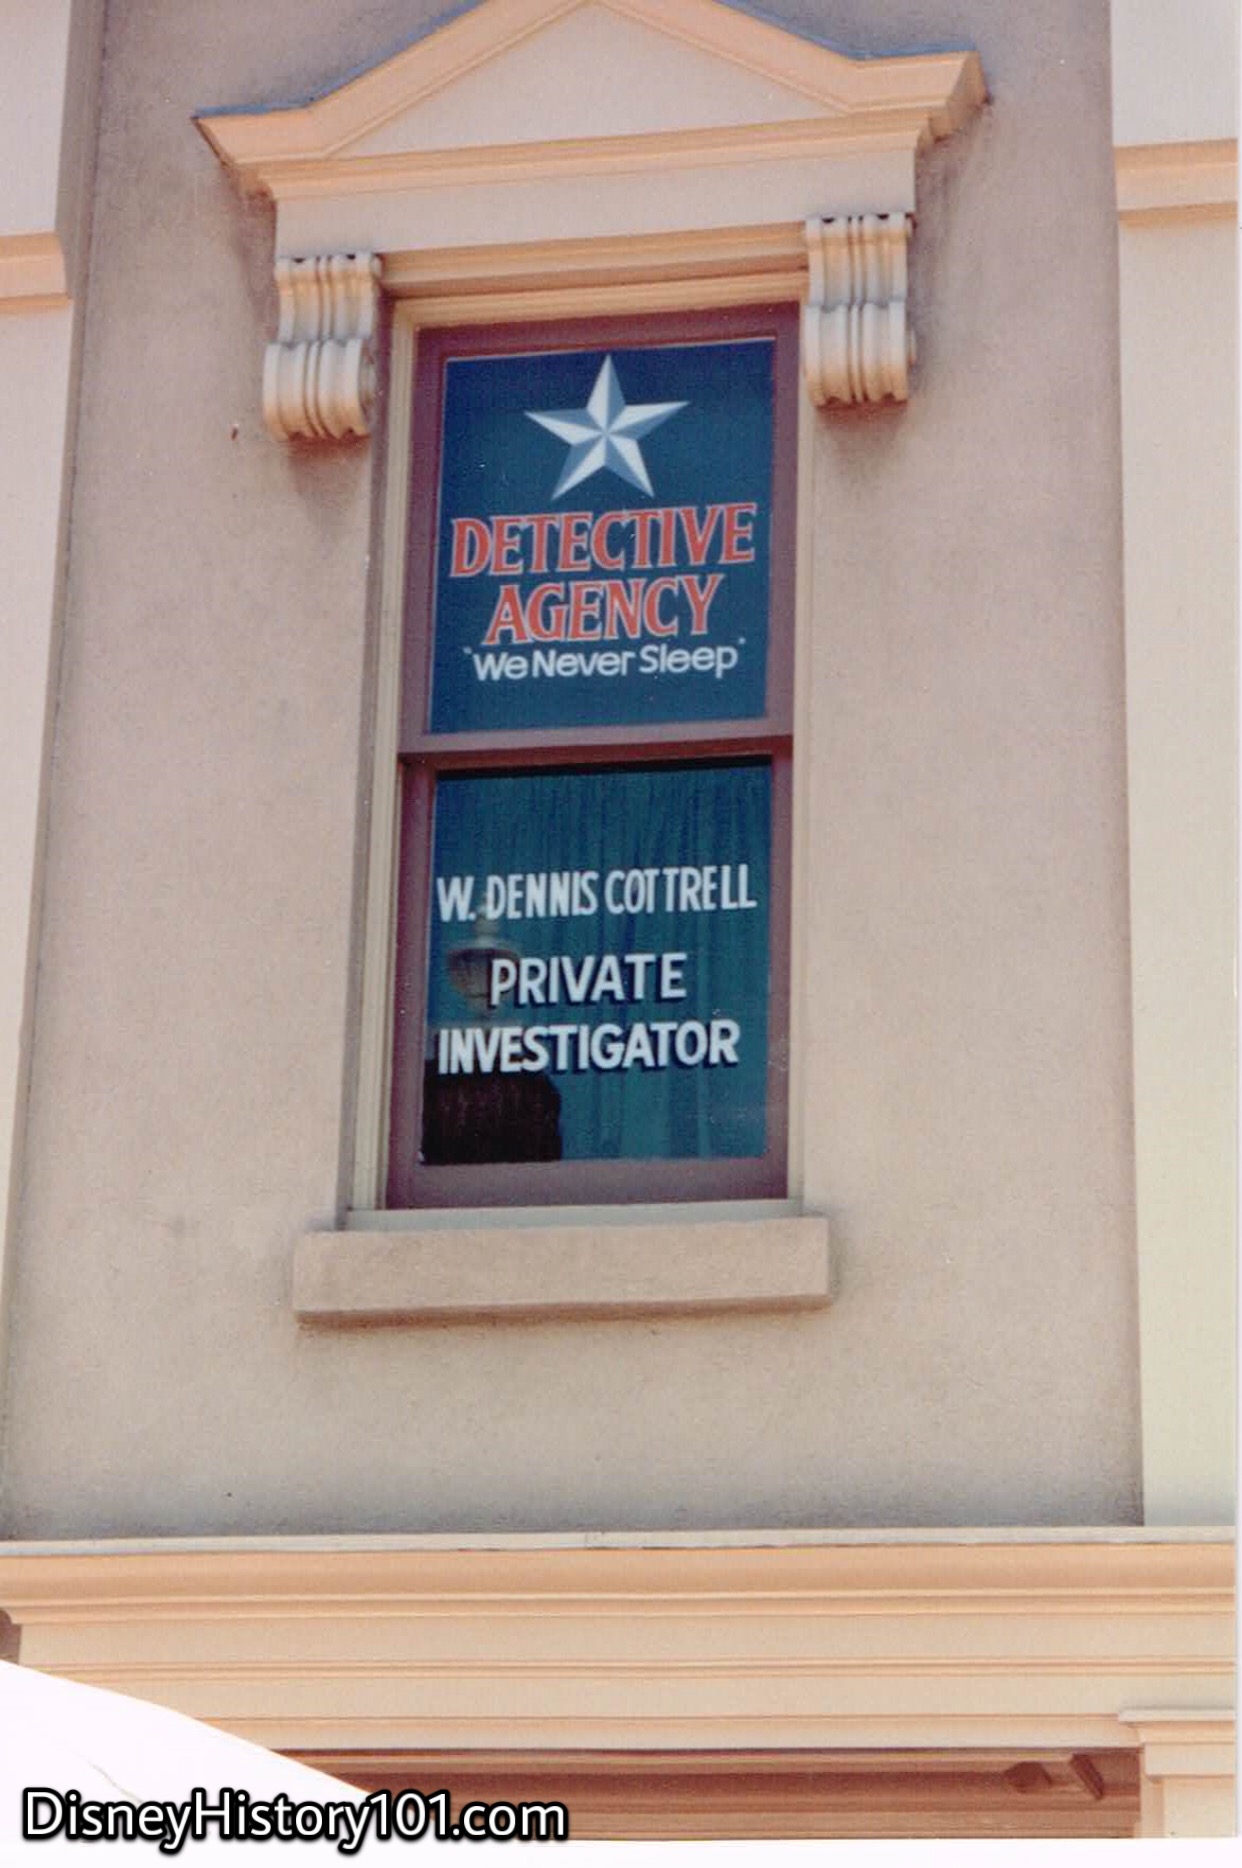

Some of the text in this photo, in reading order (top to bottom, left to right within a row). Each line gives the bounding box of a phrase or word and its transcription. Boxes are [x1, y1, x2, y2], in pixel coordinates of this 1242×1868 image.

[449, 502, 757, 578] DETECTIVE
[481, 573, 725, 646] AGENCY
[532, 648, 635, 679] Never
[436, 863, 758, 922] W. DENNIS COTTRELL
[490, 952, 688, 1007] PRIVATE
[437, 1018, 741, 1076] INVESTIGATOR
